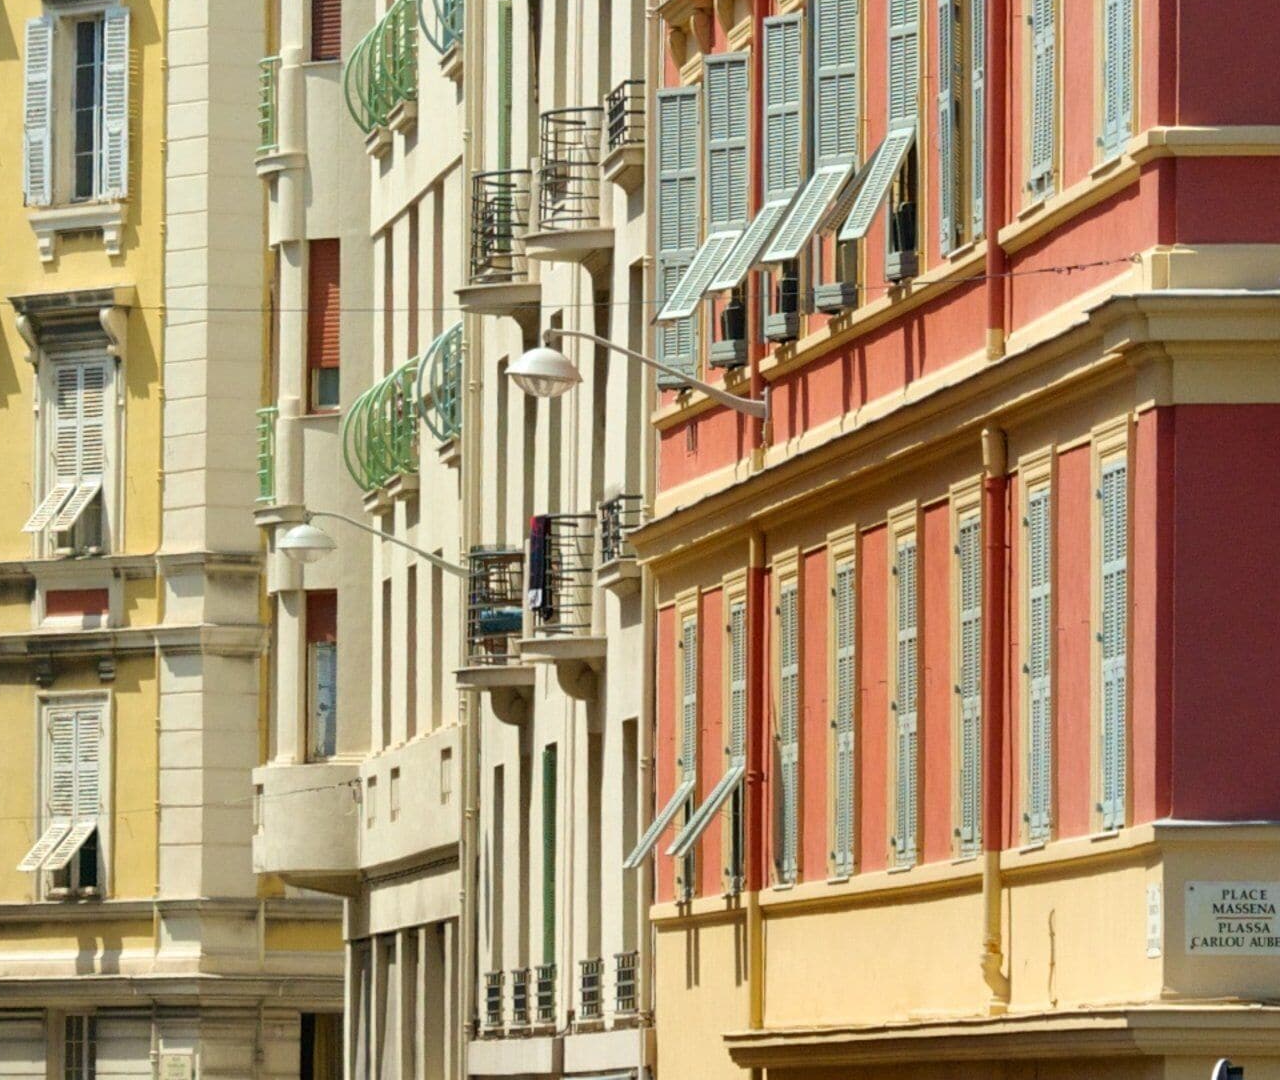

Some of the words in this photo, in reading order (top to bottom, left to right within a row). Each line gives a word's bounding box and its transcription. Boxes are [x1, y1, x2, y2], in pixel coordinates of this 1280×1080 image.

[1222, 889, 1268, 900] PLACE
[1212, 903, 1276, 914] MASSENA
[1218, 922, 1270, 933] PLASSA
[1191, 936, 1245, 947] CARLOU
